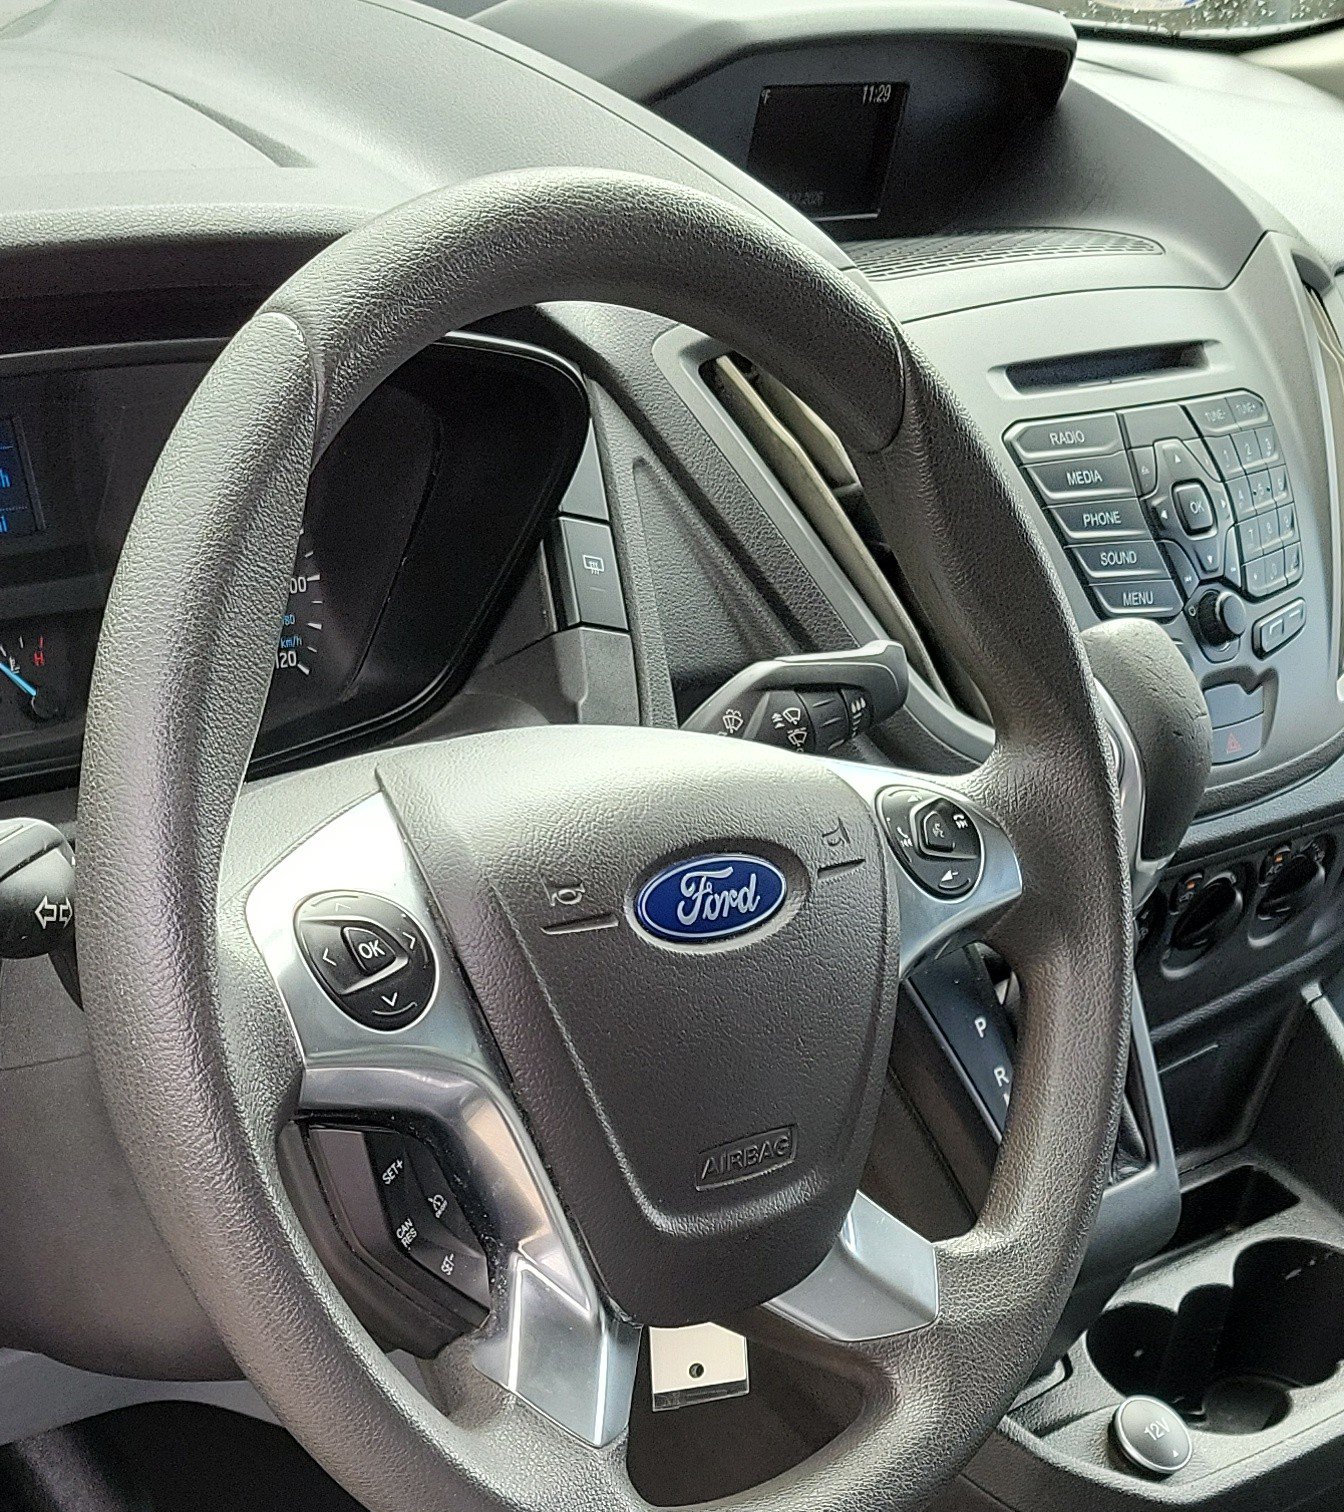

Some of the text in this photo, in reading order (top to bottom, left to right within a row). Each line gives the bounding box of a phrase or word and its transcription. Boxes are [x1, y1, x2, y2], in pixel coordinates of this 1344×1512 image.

[861, 84, 892, 104] 11:29
[1049, 430, 1085, 446] RADIO
[1066, 469, 1103, 486] MEDIA
[1189, 501, 1205, 514] OK
[1082, 511, 1122, 527] PHONE
[1100, 550, 1138, 566] SOUND
[289, 576, 307, 594] 00
[1122, 591, 1154, 607] MENU
[33, 650, 45, 667] H
[676, 866, 761, 926] Ford
[358, 939, 386, 959] OK
[974, 1017, 987, 1038] P
[993, 1066, 1010, 1087] R
[701, 1134, 790, 1180] AIRBAG
[382, 1159, 403, 1185] SET+
[396, 1218, 413, 1239] CAN
[401, 1227, 417, 1248] RES
[440, 1253, 455, 1276] SET-
[1144, 1417, 1170, 1440] 12V
